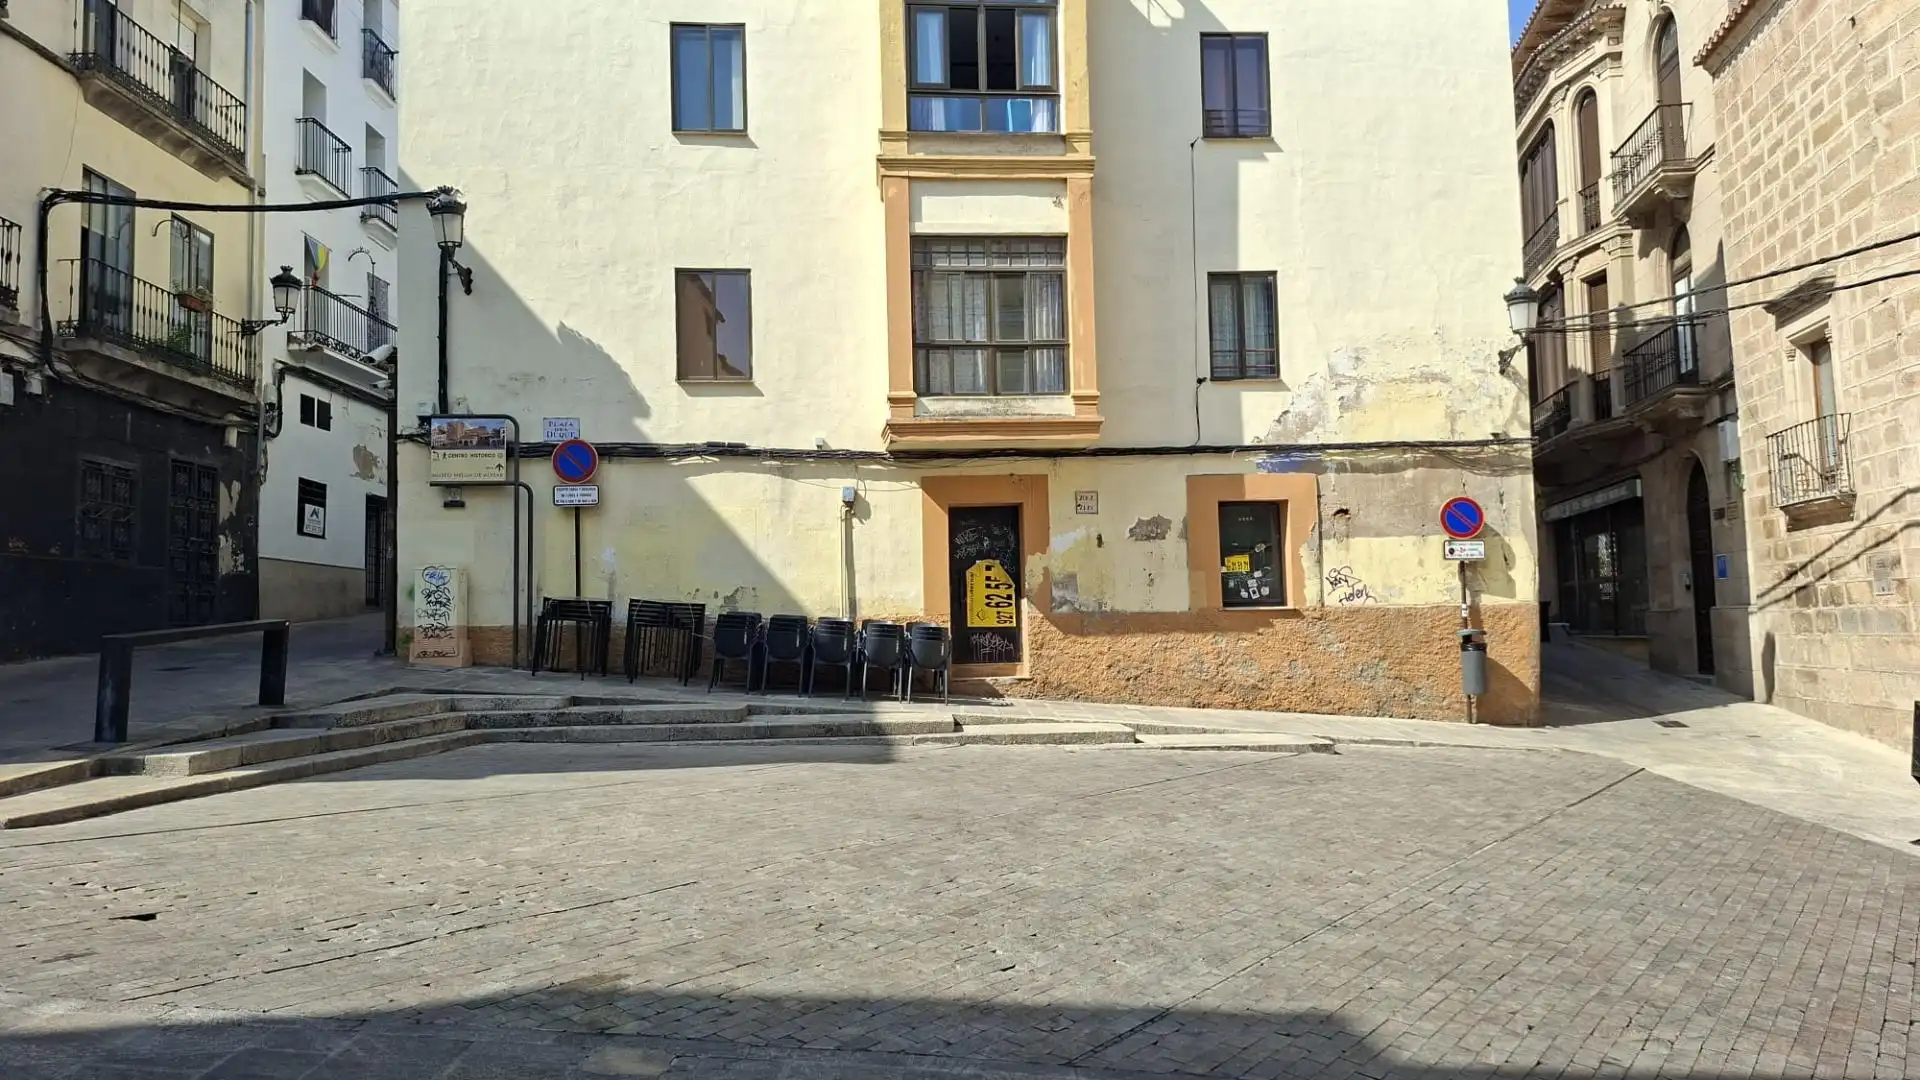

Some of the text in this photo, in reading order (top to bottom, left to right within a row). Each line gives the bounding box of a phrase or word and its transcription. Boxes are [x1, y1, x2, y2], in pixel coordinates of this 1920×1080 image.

[546, 430, 576, 438] DUQUE
[984, 594, 1013, 608] 62
[995, 611, 1013, 624] 927
